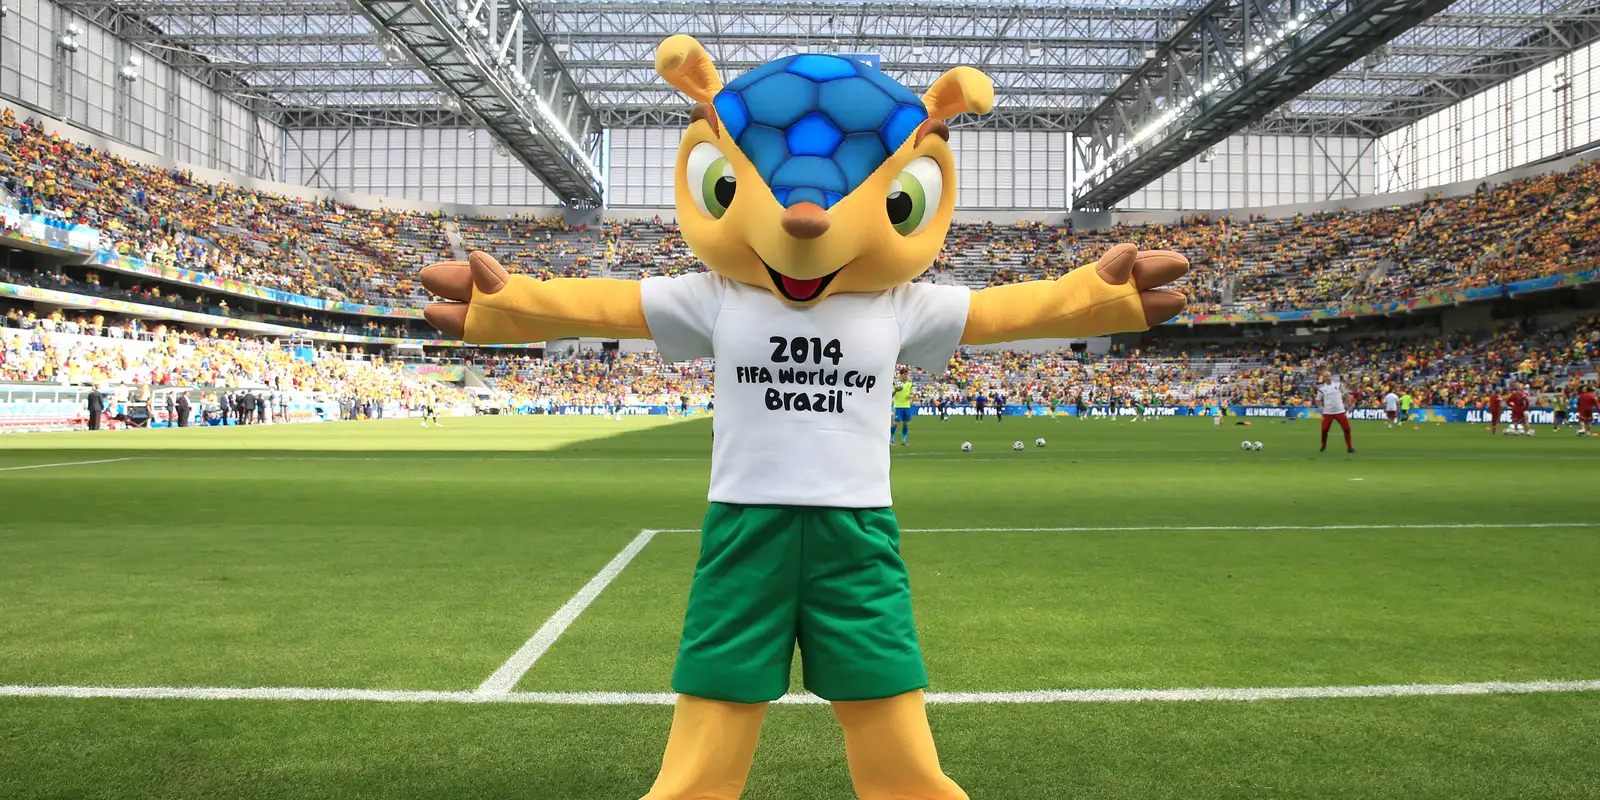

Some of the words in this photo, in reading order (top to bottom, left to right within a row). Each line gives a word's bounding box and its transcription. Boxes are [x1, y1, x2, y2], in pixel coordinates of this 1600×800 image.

[769, 336, 844, 365] 2014
[736, 366, 773, 383] FIFA
[778, 367, 838, 386] World
[843, 370, 876, 393] Cup
[564, 406, 580, 415] ALL
[582, 406, 592, 415] IN
[917, 407, 934, 416] ALL
[946, 407, 964, 416] ONE
[1465, 410, 1482, 422] ALL
